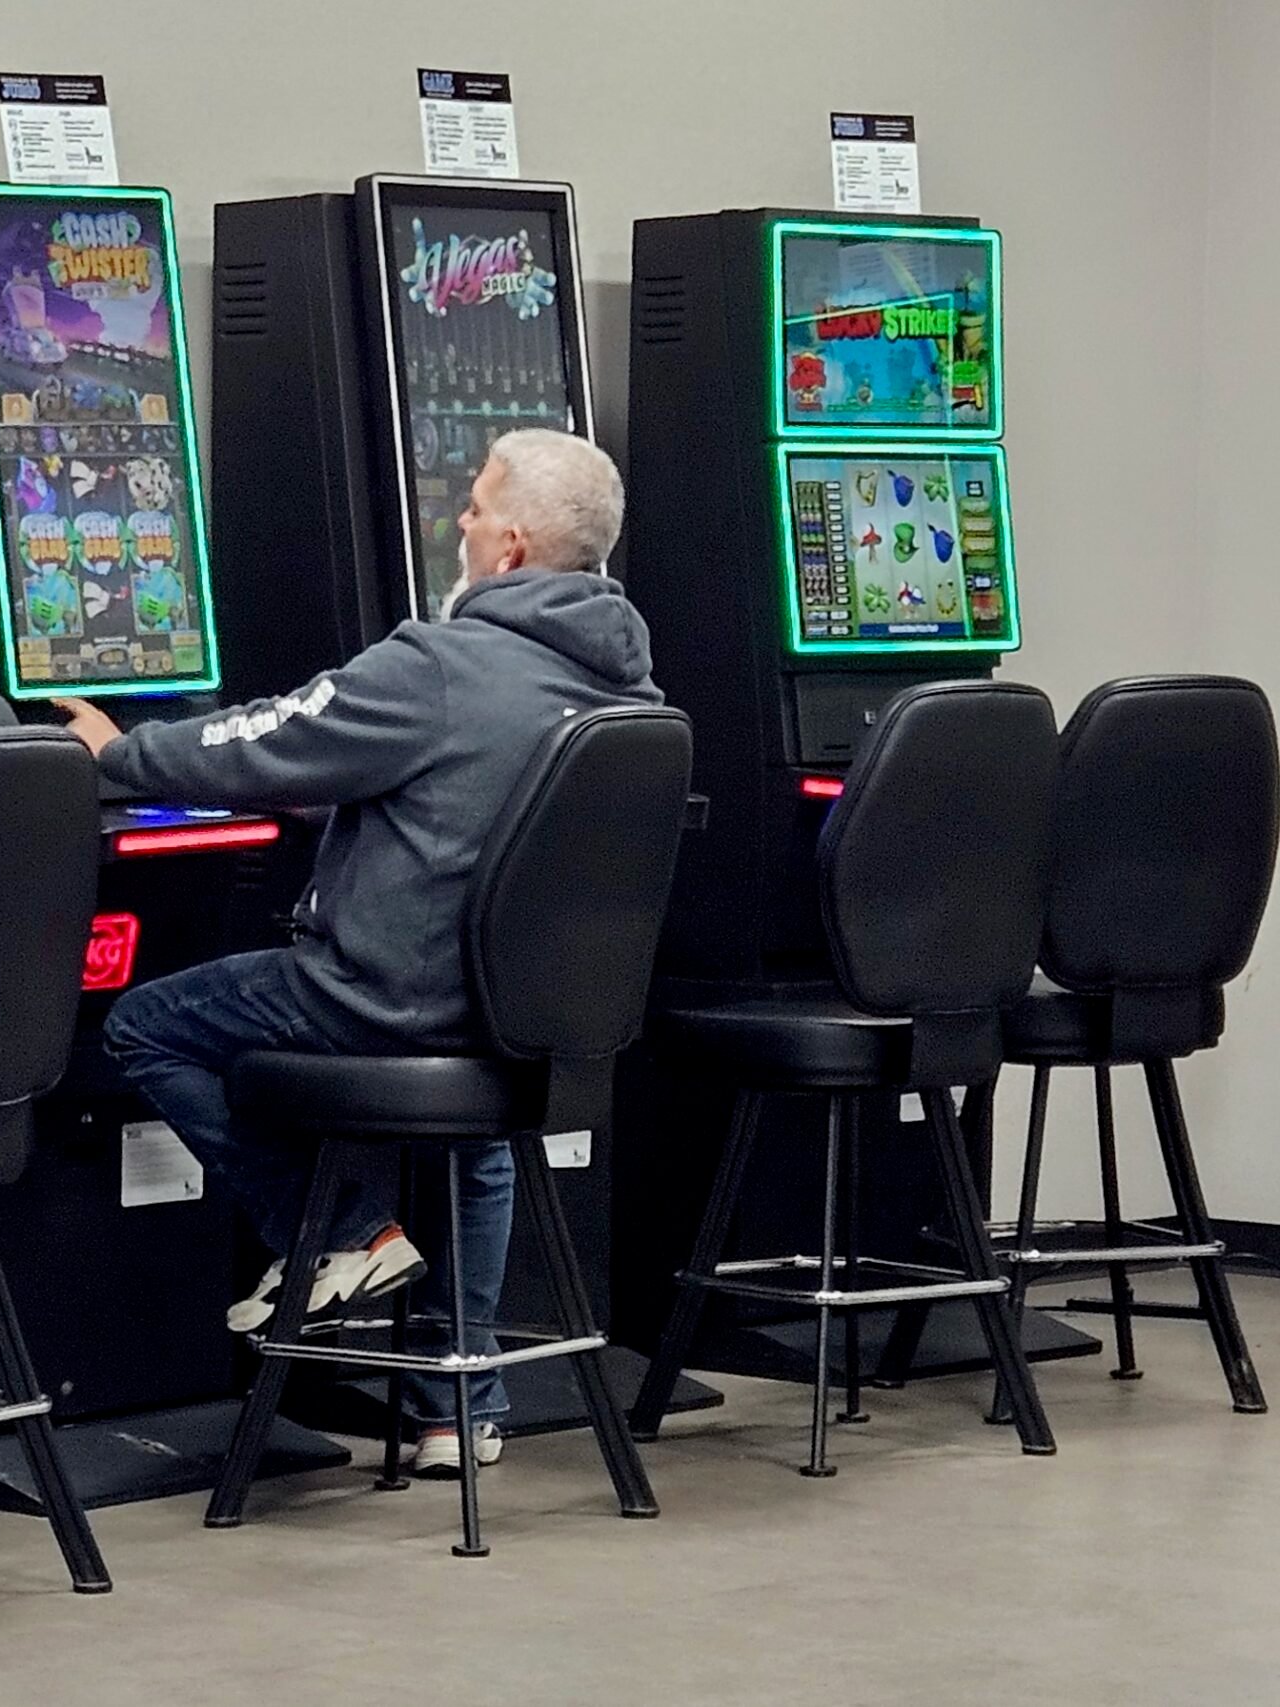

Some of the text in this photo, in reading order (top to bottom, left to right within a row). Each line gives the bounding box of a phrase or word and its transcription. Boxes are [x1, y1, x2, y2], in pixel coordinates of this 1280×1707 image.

[61, 212, 130, 249] CASH
[50, 244, 151, 288] TWISTER
[481, 272, 526, 296] MAGIC
